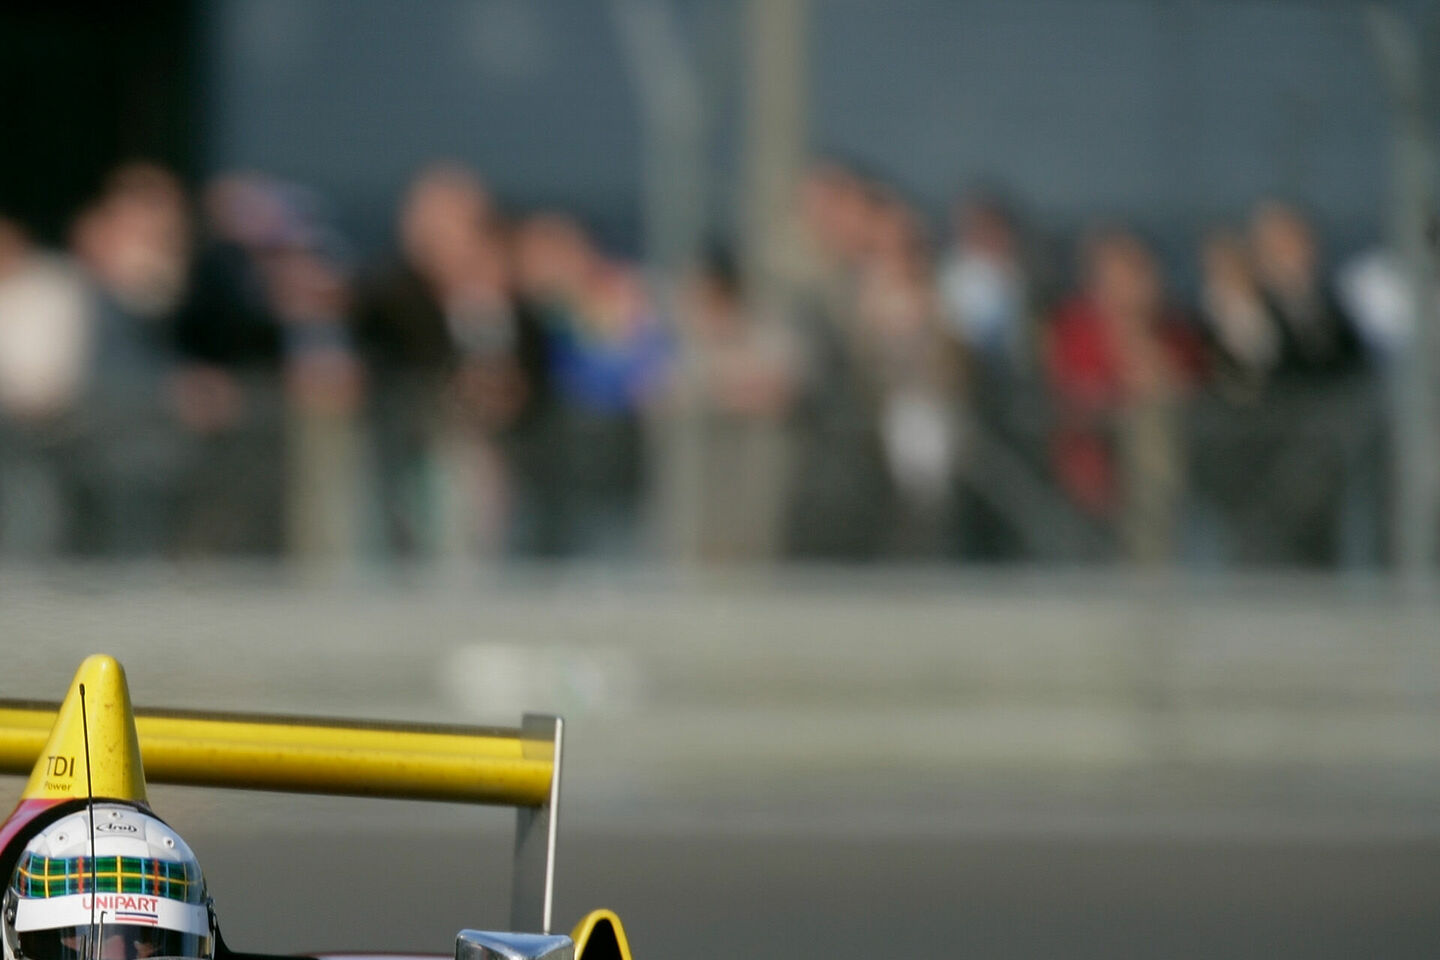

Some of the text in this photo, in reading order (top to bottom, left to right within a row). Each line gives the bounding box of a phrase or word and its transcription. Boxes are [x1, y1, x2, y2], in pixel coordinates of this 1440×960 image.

[46, 756, 75, 777] TDI
[44, 781, 72, 791] Power
[82, 896, 158, 912] UNIPART
